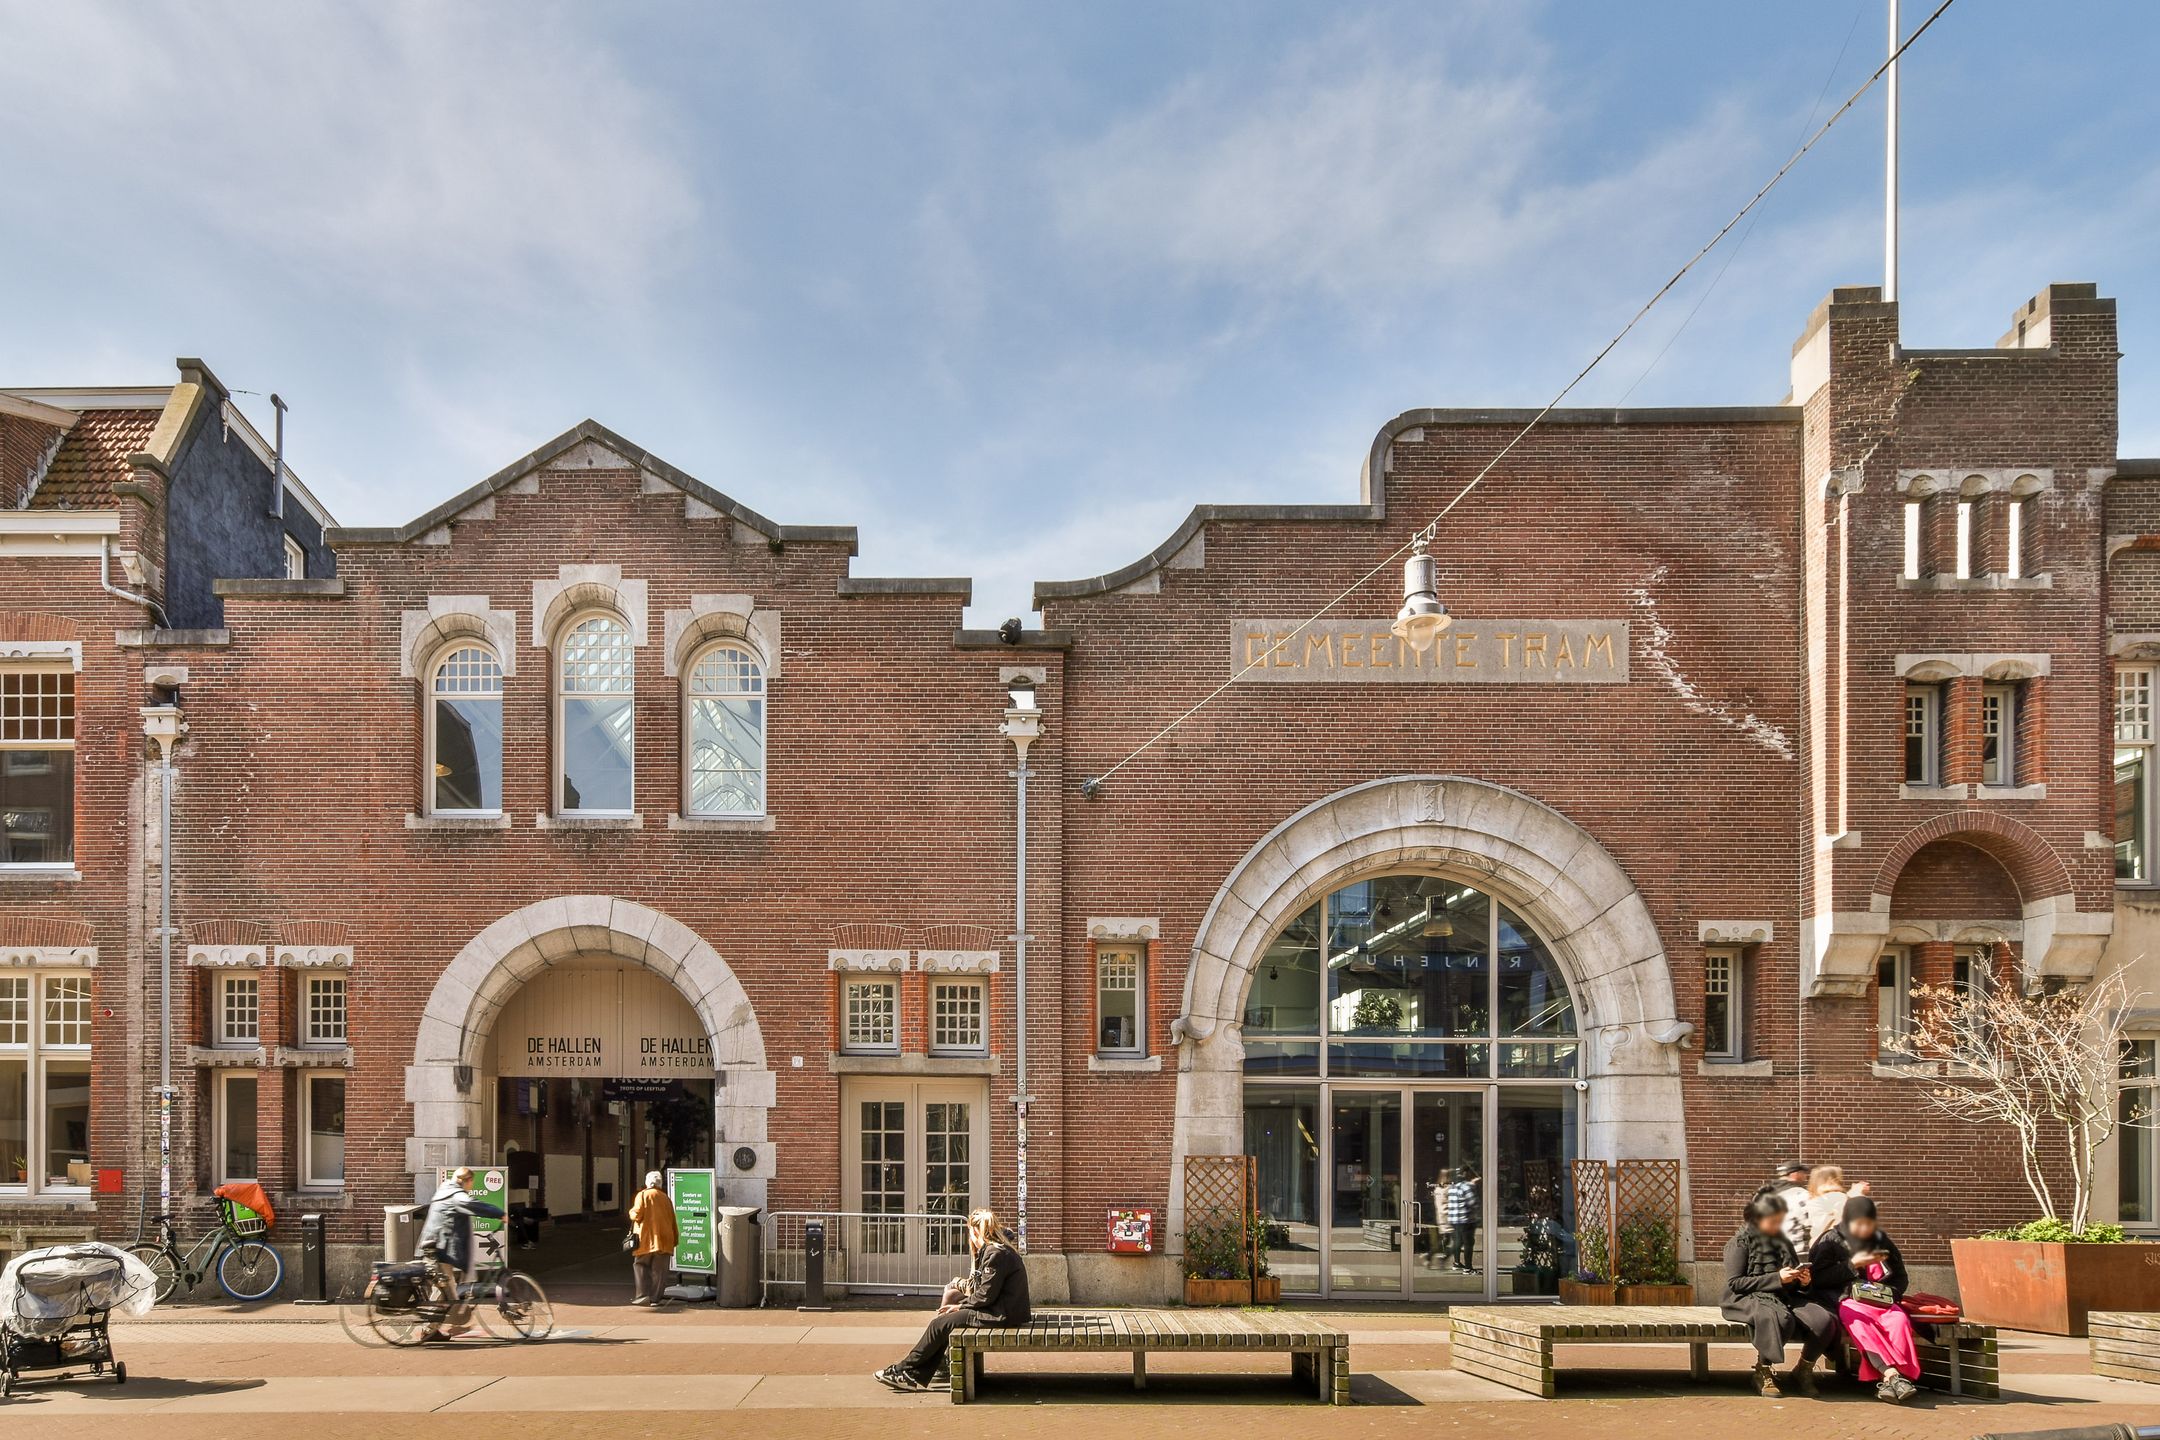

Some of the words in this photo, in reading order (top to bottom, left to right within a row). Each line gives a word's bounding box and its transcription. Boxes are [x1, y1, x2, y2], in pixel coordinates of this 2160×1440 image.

[1245, 633, 1478, 668] GEMEENTE
[1496, 633, 1614, 668] TRAM
[527, 1037, 544, 1053] DE
[549, 1037, 601, 1053] HALLEN
[641, 1037, 657, 1053] DE
[662, 1037, 712, 1054] HALLEN
[528, 1056, 601, 1066] AMSTERDAM
[641, 1056, 715, 1067] AMSTERDAM
[472, 1220, 490, 1229] allen
